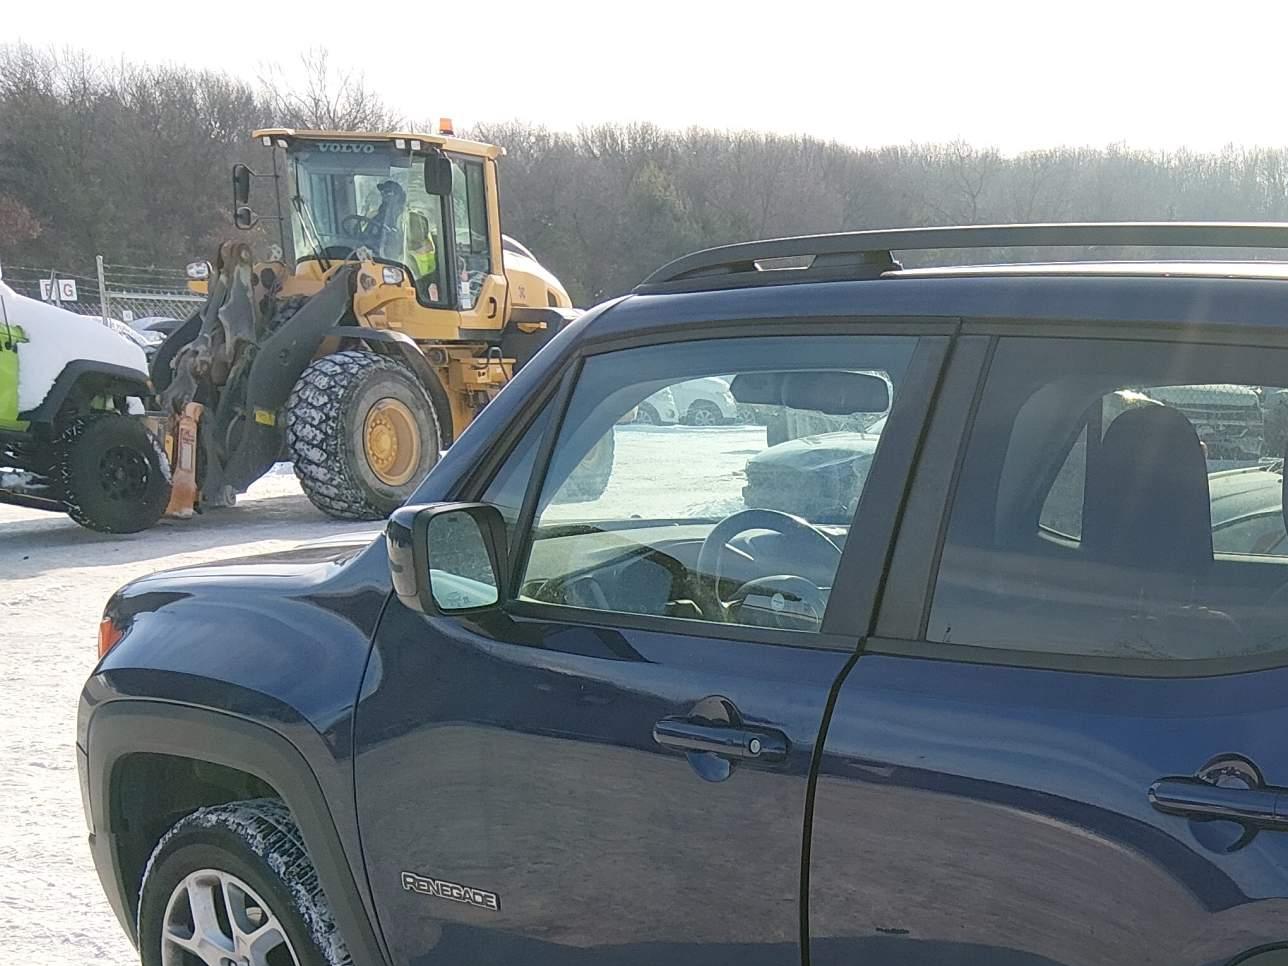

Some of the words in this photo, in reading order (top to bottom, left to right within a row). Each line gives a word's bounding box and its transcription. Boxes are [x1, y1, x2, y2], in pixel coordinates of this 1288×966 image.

[318, 142, 375, 154] VOLVO
[63, 283, 74, 297] G
[401, 870, 499, 911] RENEGADE
